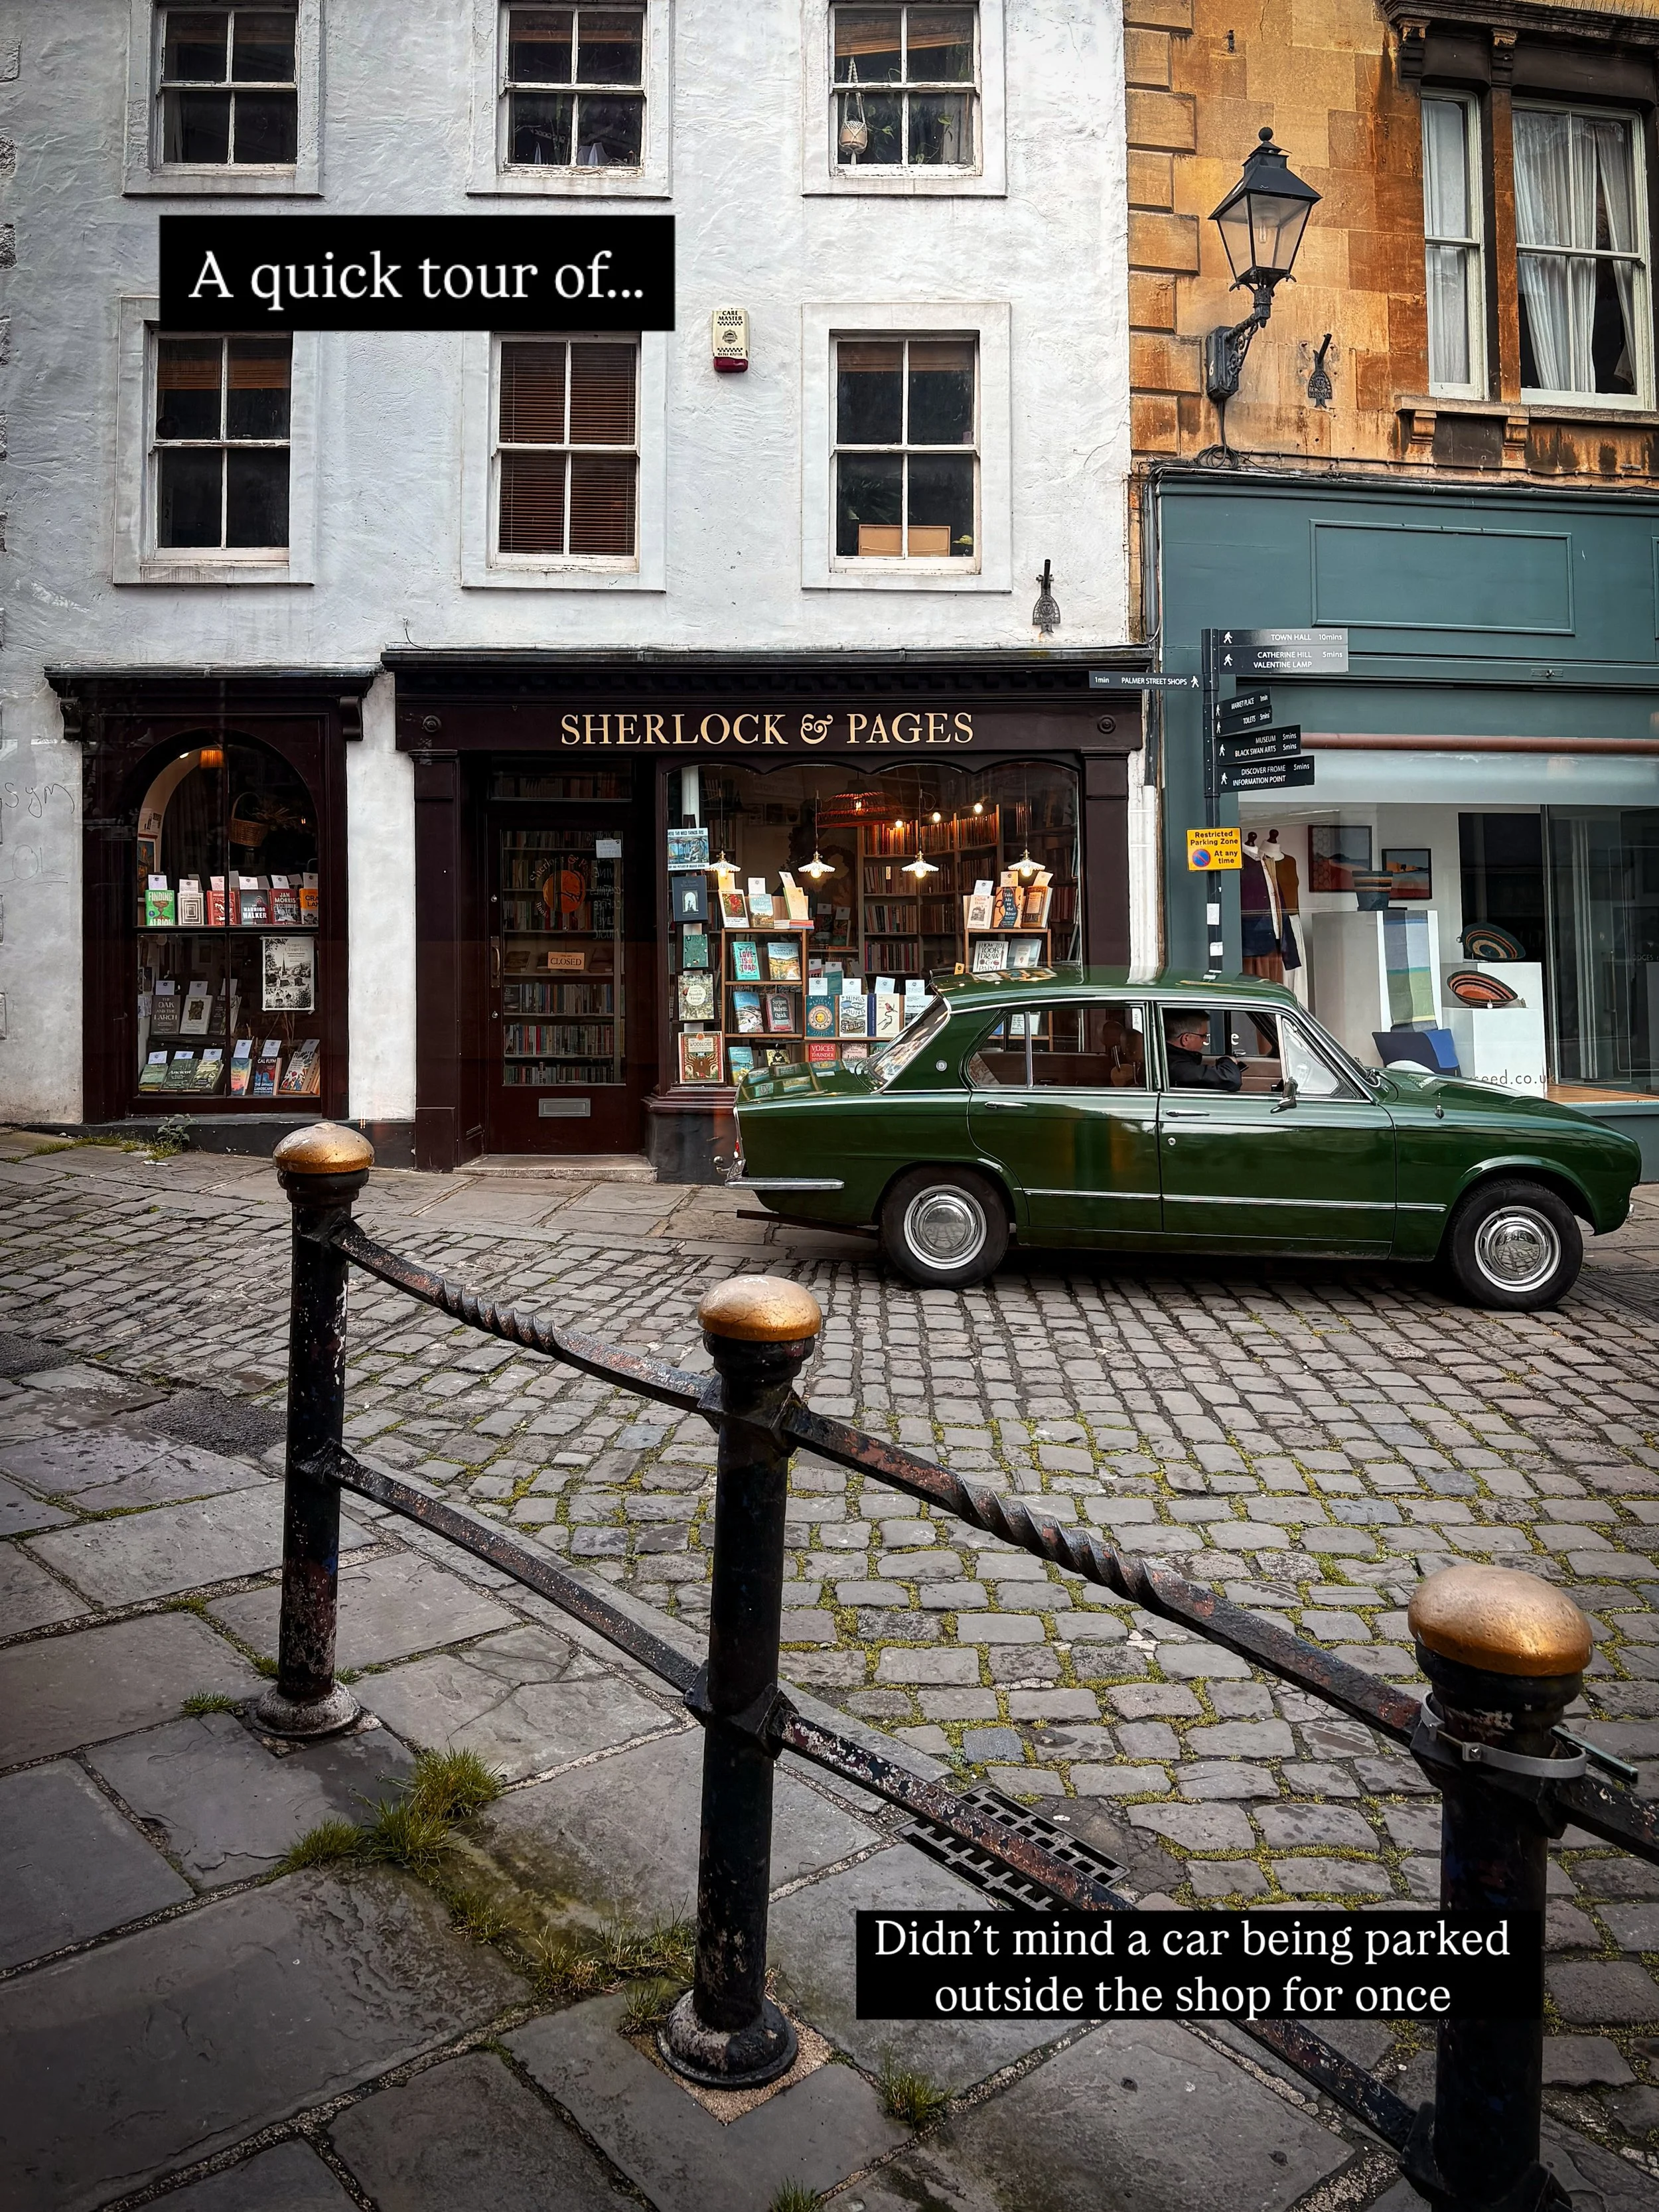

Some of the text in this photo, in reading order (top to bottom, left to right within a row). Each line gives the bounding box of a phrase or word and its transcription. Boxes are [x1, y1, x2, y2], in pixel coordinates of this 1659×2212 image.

[1209, 360, 1214, 376] 6
[1231, 701, 1244, 709] MARKET
[1244, 698, 1254, 707] PLACE
[1242, 715, 1256, 725] TOILETS
[561, 712, 974, 745] SHERLOCK & PAGES
[1256, 735, 1276, 744] MUSEUM
[1235, 749, 1250, 757] BLACK
[1264, 745, 1277, 754] ARTS
[1241, 766, 1266, 775] DISCOVER
[1233, 776, 1269, 786] INFORMATION
[149, 892, 173, 901] FINDING
[841, 1021, 865, 1033] GROUND
[1469, 1068, 1555, 1084] seed.co.uk
